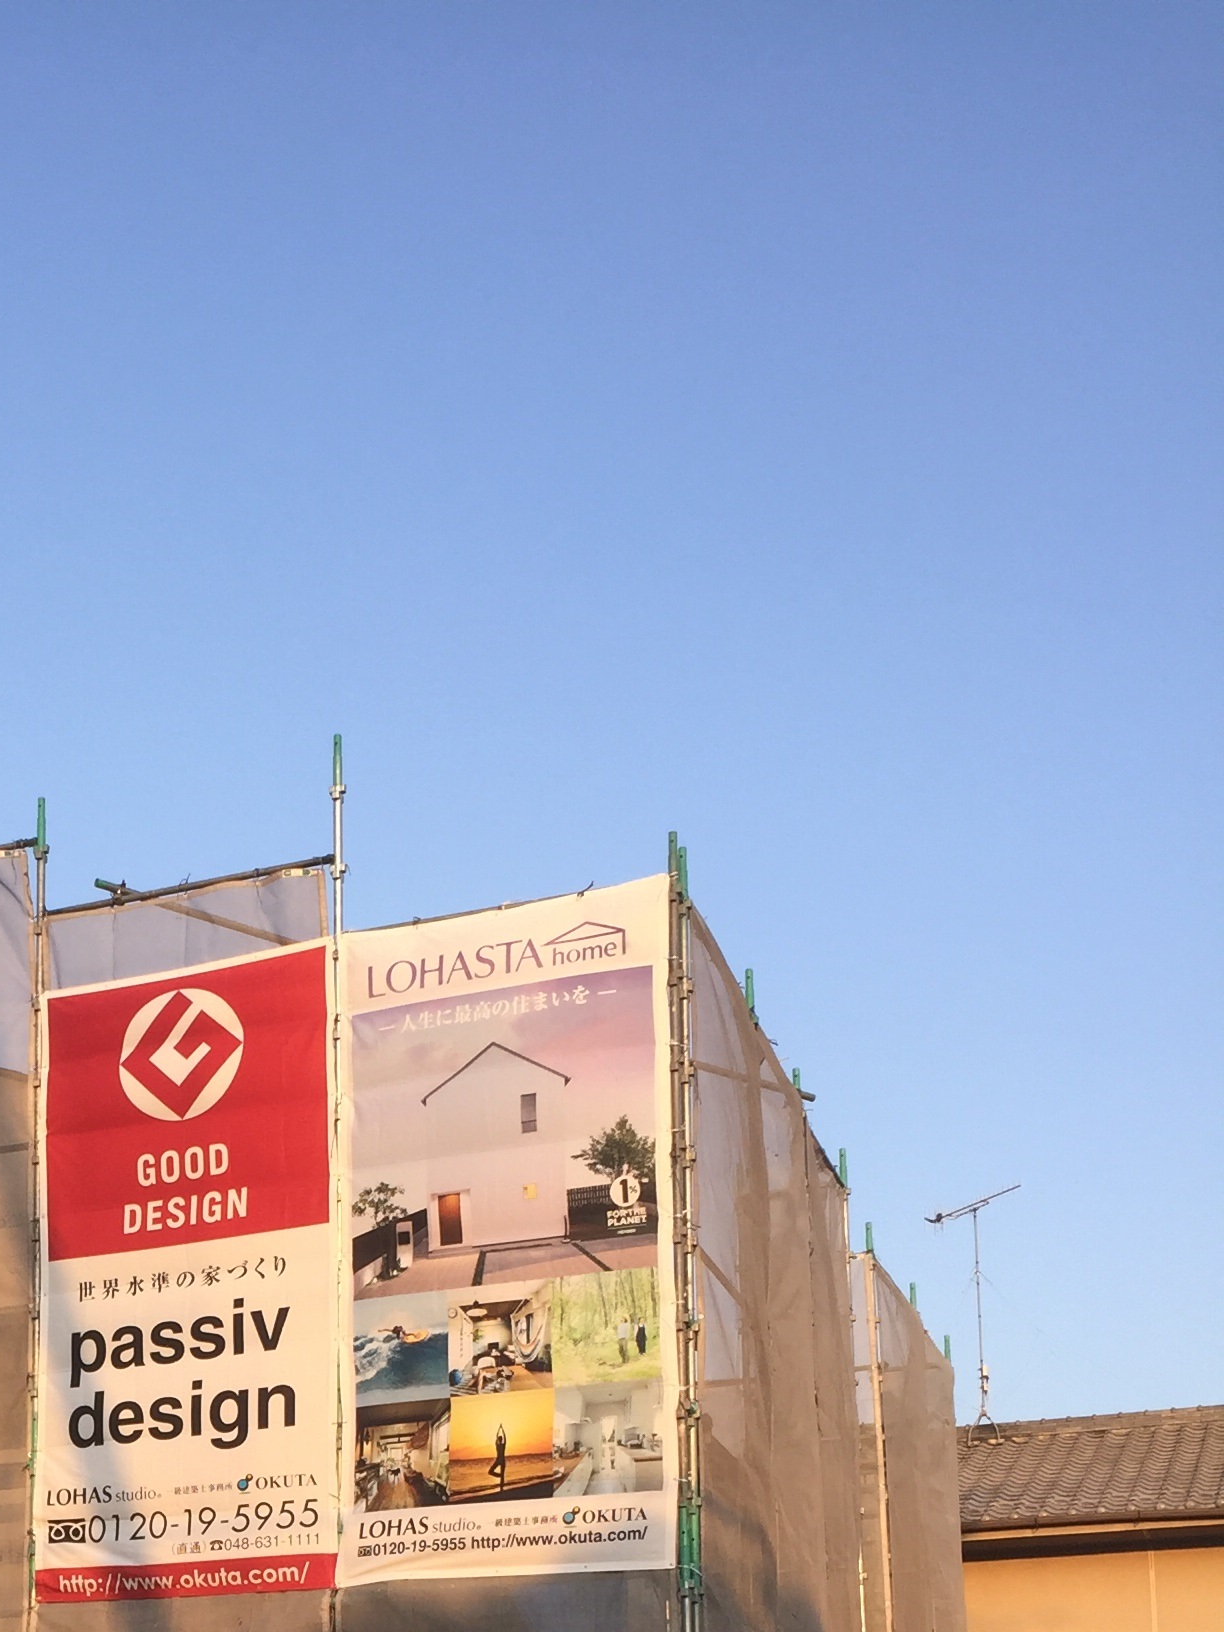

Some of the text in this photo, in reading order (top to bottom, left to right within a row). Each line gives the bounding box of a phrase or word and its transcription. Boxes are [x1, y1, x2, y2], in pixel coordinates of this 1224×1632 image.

[368, 938, 617, 998] LOHASTA home
[137, 1143, 229, 1187] GOOD
[123, 1187, 248, 1235] DESIGN
[607, 1214, 647, 1227] PLANET
[77, 1255, 287, 1303] 世界水準の家づくり
[69, 1297, 291, 1389] passiv
[68, 1379, 296, 1450] design
[46, 1485, 113, 1506] LOHAS
[255, 1473, 318, 1490] OKUTA
[88, 1498, 319, 1543] 0120-19-5955
[224, 1533, 320, 1551] 048-631-1111
[359, 1516, 429, 1539] LOHAS
[582, 1507, 648, 1524] OKUTA
[372, 1526, 648, 1556] 0120-19-5955 http://www.okuta.com/
[58, 1561, 310, 1597] http://www.okuta.com/
